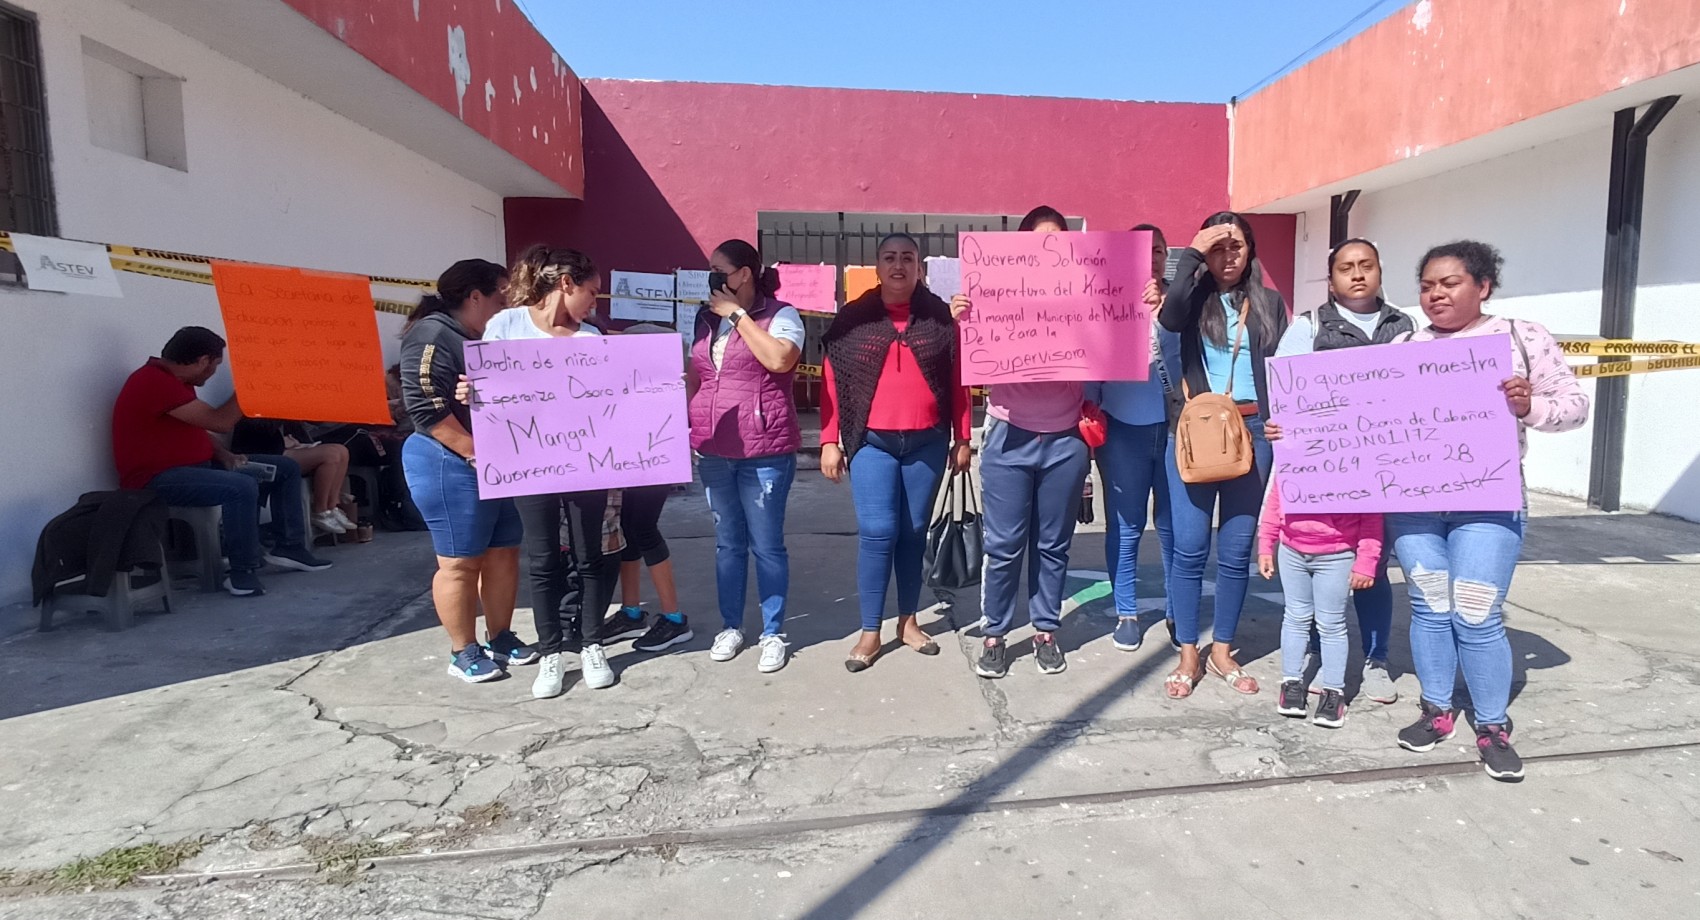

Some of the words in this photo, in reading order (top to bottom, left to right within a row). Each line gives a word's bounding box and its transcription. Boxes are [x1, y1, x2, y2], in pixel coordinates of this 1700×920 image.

[962, 235, 1040, 267] Queremos
[1043, 234, 1107, 268] Solución
[35, 255, 95, 276] ASTEV
[218, 269, 253, 296] La
[342, 289, 361, 304] de
[964, 271, 1047, 302] Reapertura
[1054, 280, 1072, 296] del
[1083, 274, 1124, 296] Kinder
[968, 309, 980, 324] El
[986, 307, 1024, 331] mangal
[1037, 311, 1083, 327] Municipio
[1089, 308, 1100, 322] de
[964, 326, 984, 345] De
[1009, 329, 1037, 342] cara
[1046, 328, 1057, 338] la
[1556, 342, 1591, 353] PASO
[1604, 342, 1679, 354] PROHIBIDO
[1682, 343, 1698, 354] EL
[533, 350, 554, 369] de
[969, 348, 1087, 375] Supervisora
[1267, 361, 1306, 395] No
[1314, 369, 1405, 391] queremos
[1418, 348, 1497, 376] maestra
[470, 376, 557, 409] Esperanza
[1271, 398, 1288, 414] de
[1285, 423, 1348, 439] speranza
[1409, 412, 1428, 425] de
[588, 446, 670, 473] Maestros
[1376, 451, 1431, 465] Sector
[1443, 443, 1474, 463] 28
[1280, 480, 1370, 505] Queremos
[1375, 470, 1483, 499] Respuesta
